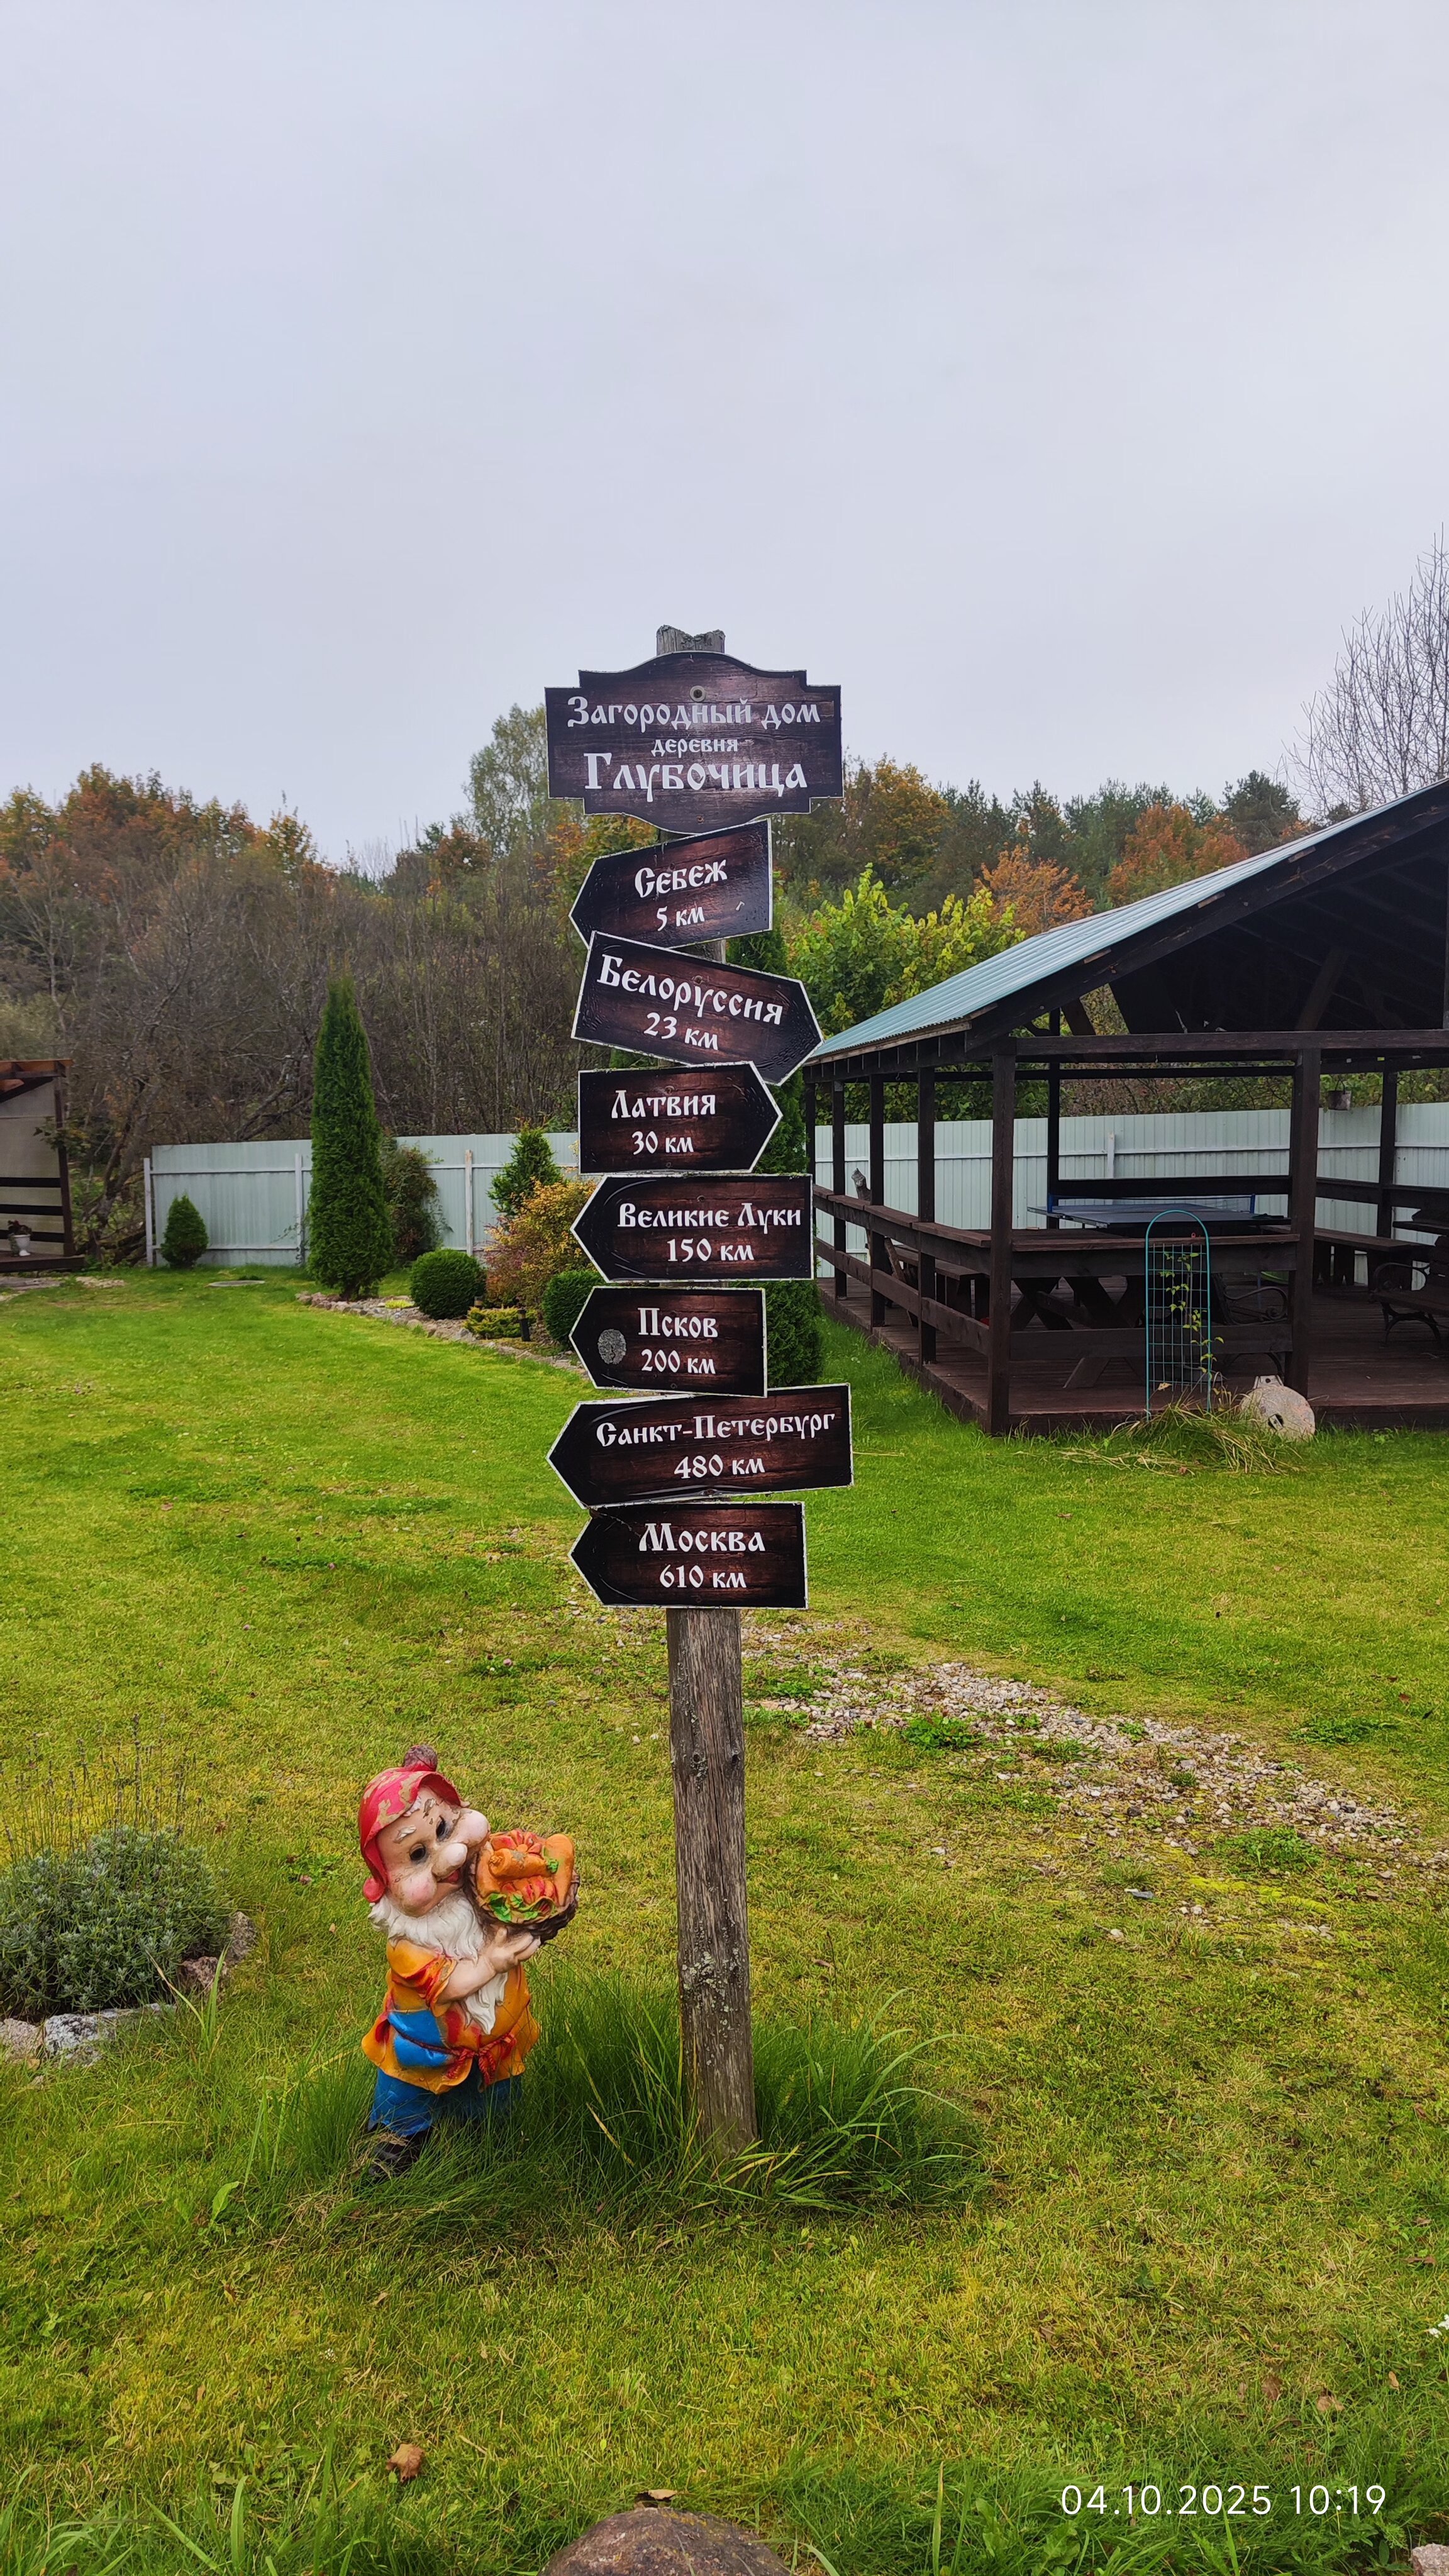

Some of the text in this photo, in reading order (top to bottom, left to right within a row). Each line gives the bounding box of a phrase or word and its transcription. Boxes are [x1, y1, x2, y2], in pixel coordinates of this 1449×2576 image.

[567, 696, 820, 733] Загородный дом
[651, 739, 738, 758] деревня
[584, 753, 807, 802] Глубочица
[635, 860, 727, 898] Себеж
[657, 906, 704, 931] 5 км
[597, 954, 783, 1024] Белоруссия
[643, 1013, 718, 1050] 23 км
[611, 1090, 716, 1118] Латвия
[631, 1131, 694, 1155] 30 км
[617, 1202, 801, 1234] Великие Луки
[667, 1238, 754, 1262] 150 км
[637, 1307, 718, 1338] Псков
[641, 1349, 716, 1374] 200 км
[596, 1413, 835, 1446] Санкт-Петербург
[674, 1454, 765, 1479] 480 км
[638, 1523, 765, 1552] Москва
[659, 1565, 747, 1588] 610 км
